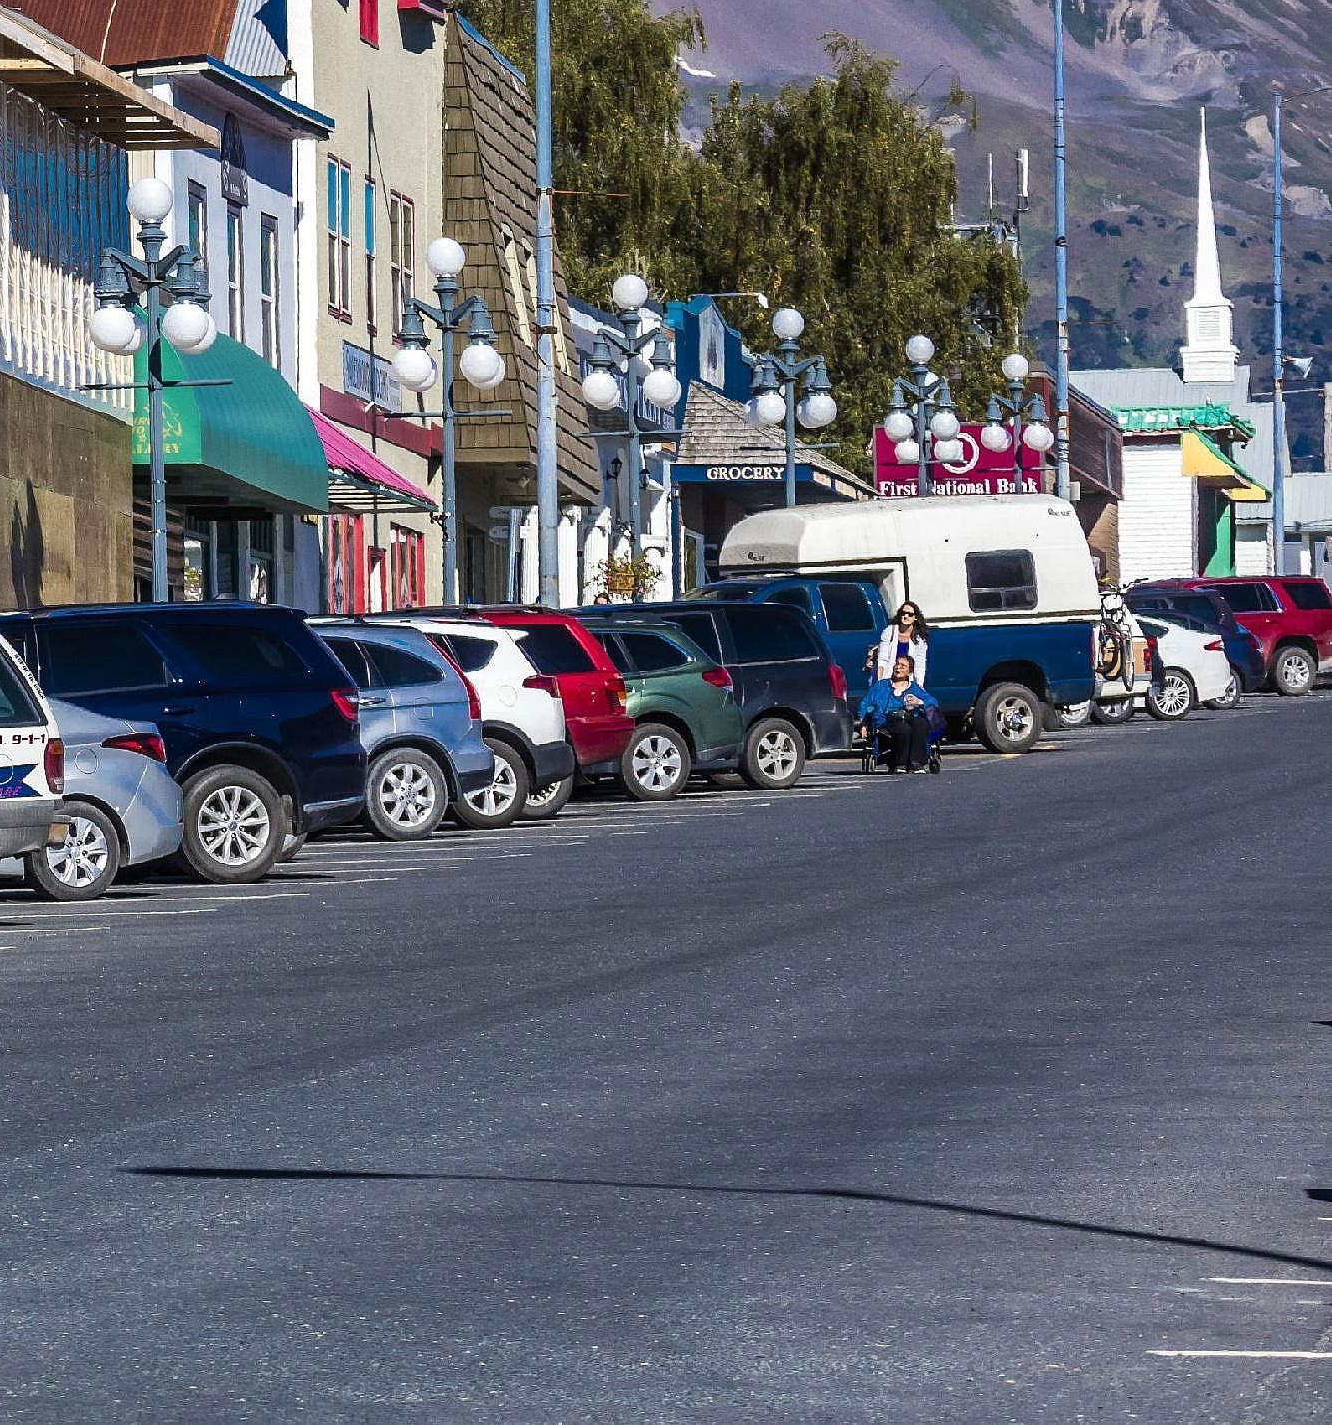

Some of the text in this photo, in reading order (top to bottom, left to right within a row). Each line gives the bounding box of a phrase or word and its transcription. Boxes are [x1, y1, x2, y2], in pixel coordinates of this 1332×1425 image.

[706, 467, 785, 480] GROCERY
[879, 480, 918, 496] First
[12, 734, 46, 744] 9-1-1
